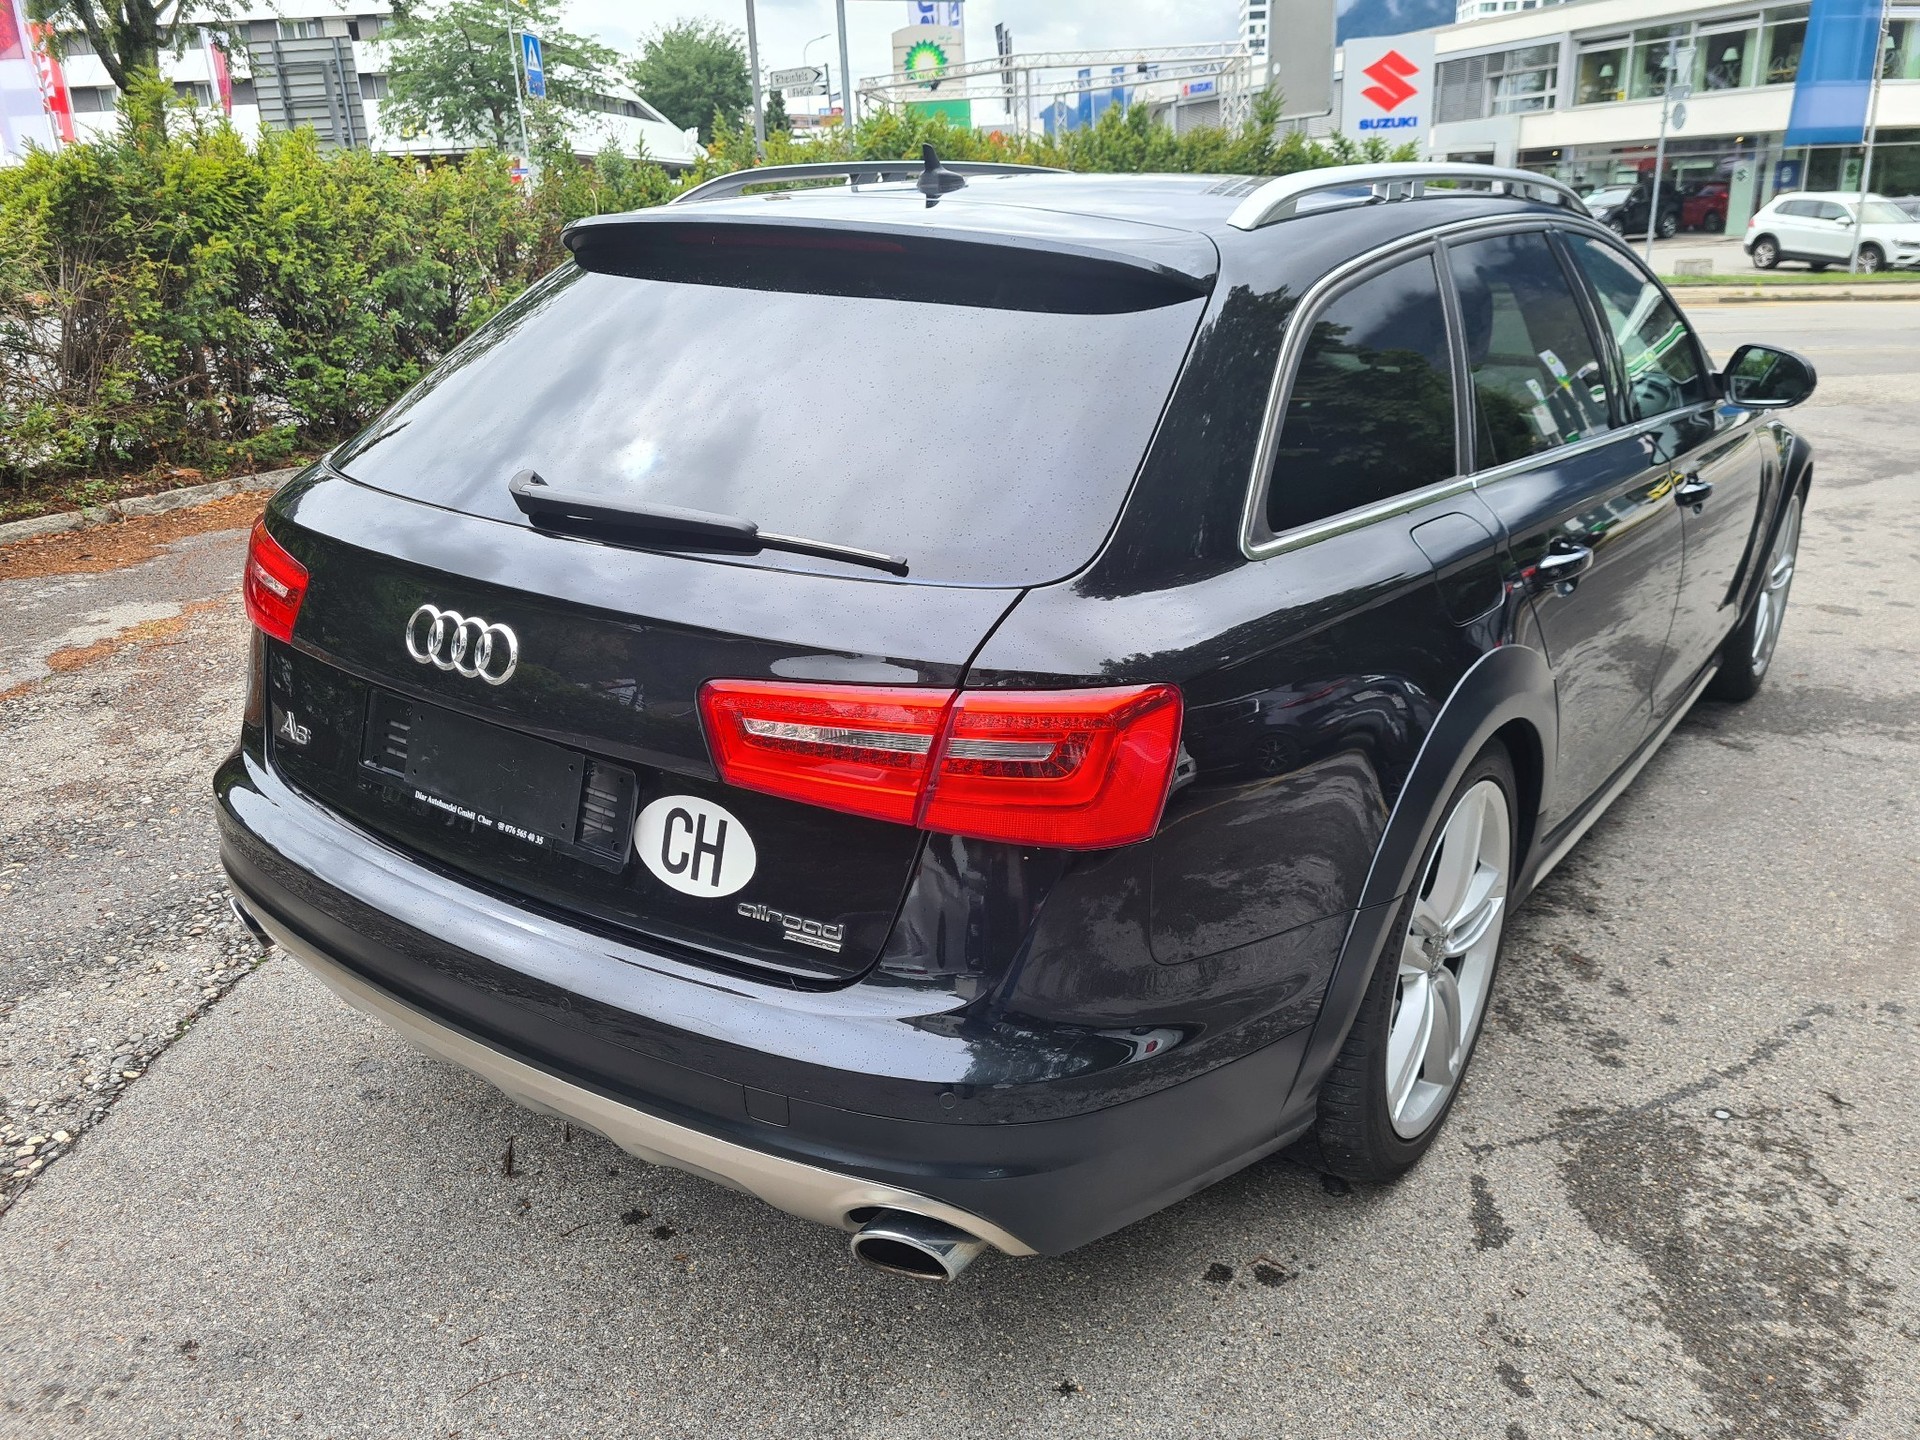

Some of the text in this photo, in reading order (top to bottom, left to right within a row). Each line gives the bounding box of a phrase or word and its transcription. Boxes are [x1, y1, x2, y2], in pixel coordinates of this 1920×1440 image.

[1359, 116, 1418, 130] SUZUKI
[280, 711, 312, 745] A6
[457, 806, 476, 820] GmbH
[535, 835, 544, 845] 35
[661, 807, 728, 887] CH
[737, 902, 845, 941] allroad
